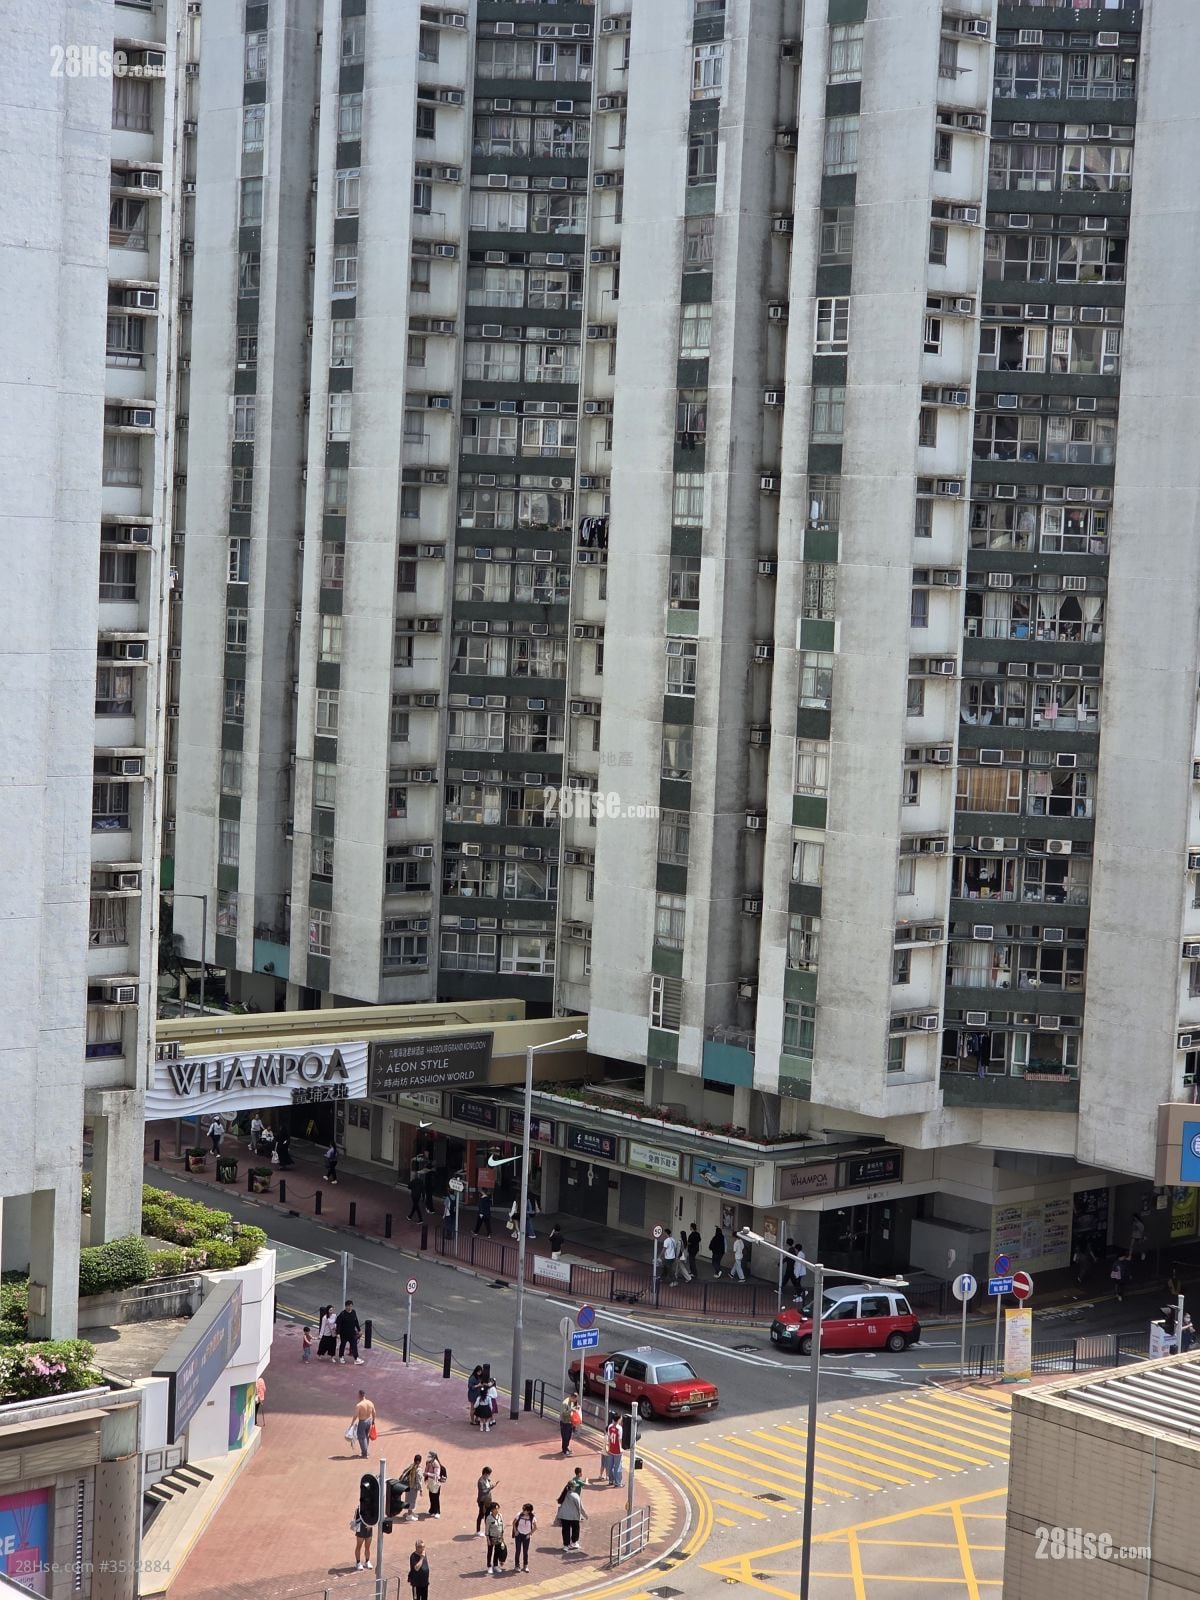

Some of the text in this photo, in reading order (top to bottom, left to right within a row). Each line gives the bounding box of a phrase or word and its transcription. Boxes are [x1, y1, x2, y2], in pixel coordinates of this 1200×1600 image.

[167, 1048, 349, 1096] WHAMPOA
[386, 1058, 449, 1074] AEON STYLE
[409, 1074, 446, 1085] FASHION
[446, 1070, 475, 1081] WORLD
[790, 1173, 828, 1187] WHAMPOA
[573, 1332, 587, 1340] Private
